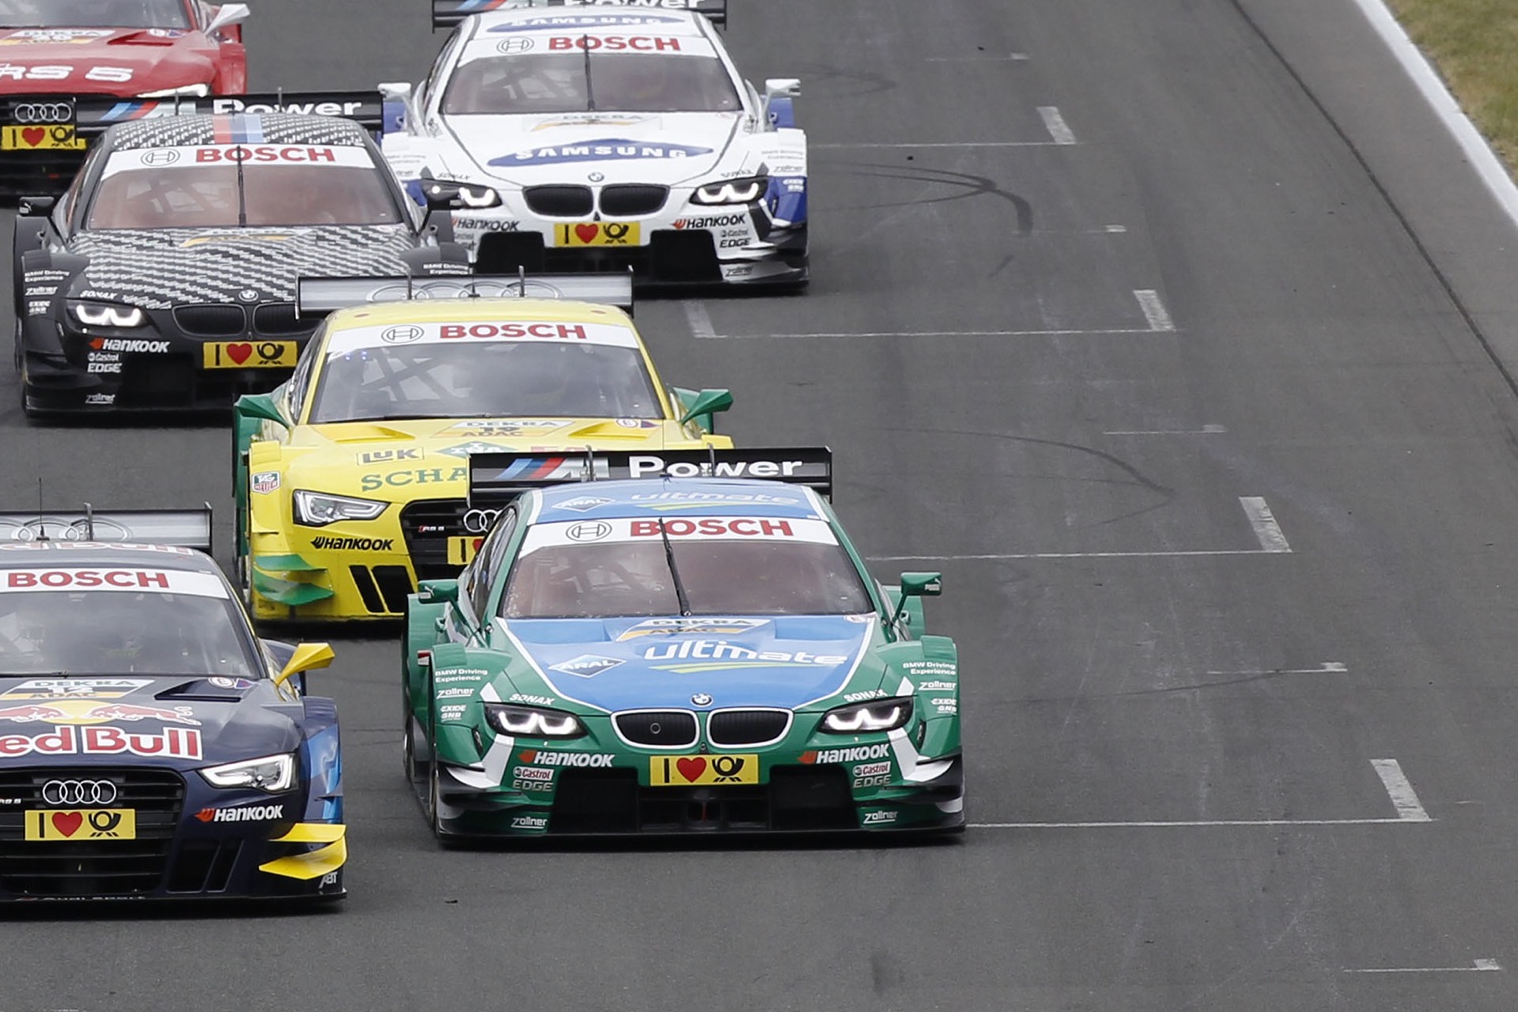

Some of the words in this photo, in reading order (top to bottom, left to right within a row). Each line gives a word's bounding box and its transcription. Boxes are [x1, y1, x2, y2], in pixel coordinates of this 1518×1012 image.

[547, 35, 682, 52] BOSCH
[85, 66, 134, 83] 5
[212, 98, 362, 116] Power
[195, 147, 336, 163] BOSCH
[514, 144, 688, 160] SAMSUNG
[439, 324, 587, 339] BOSCH
[86, 362, 122, 374] EDGE
[629, 455, 803, 479] Power
[630, 519, 794, 537] BOSCH
[7, 571, 170, 589] BOSCH
[644, 639, 849, 665] ultimate
[559, 659, 617, 670] ARAL
[508, 692, 555, 706] SONAX
[83, 726, 201, 759] Bull
[521, 768, 551, 780] Castrol
[862, 763, 890, 775] Castrol
[512, 779, 555, 792] EDGE
[853, 774, 892, 789] EDGE
